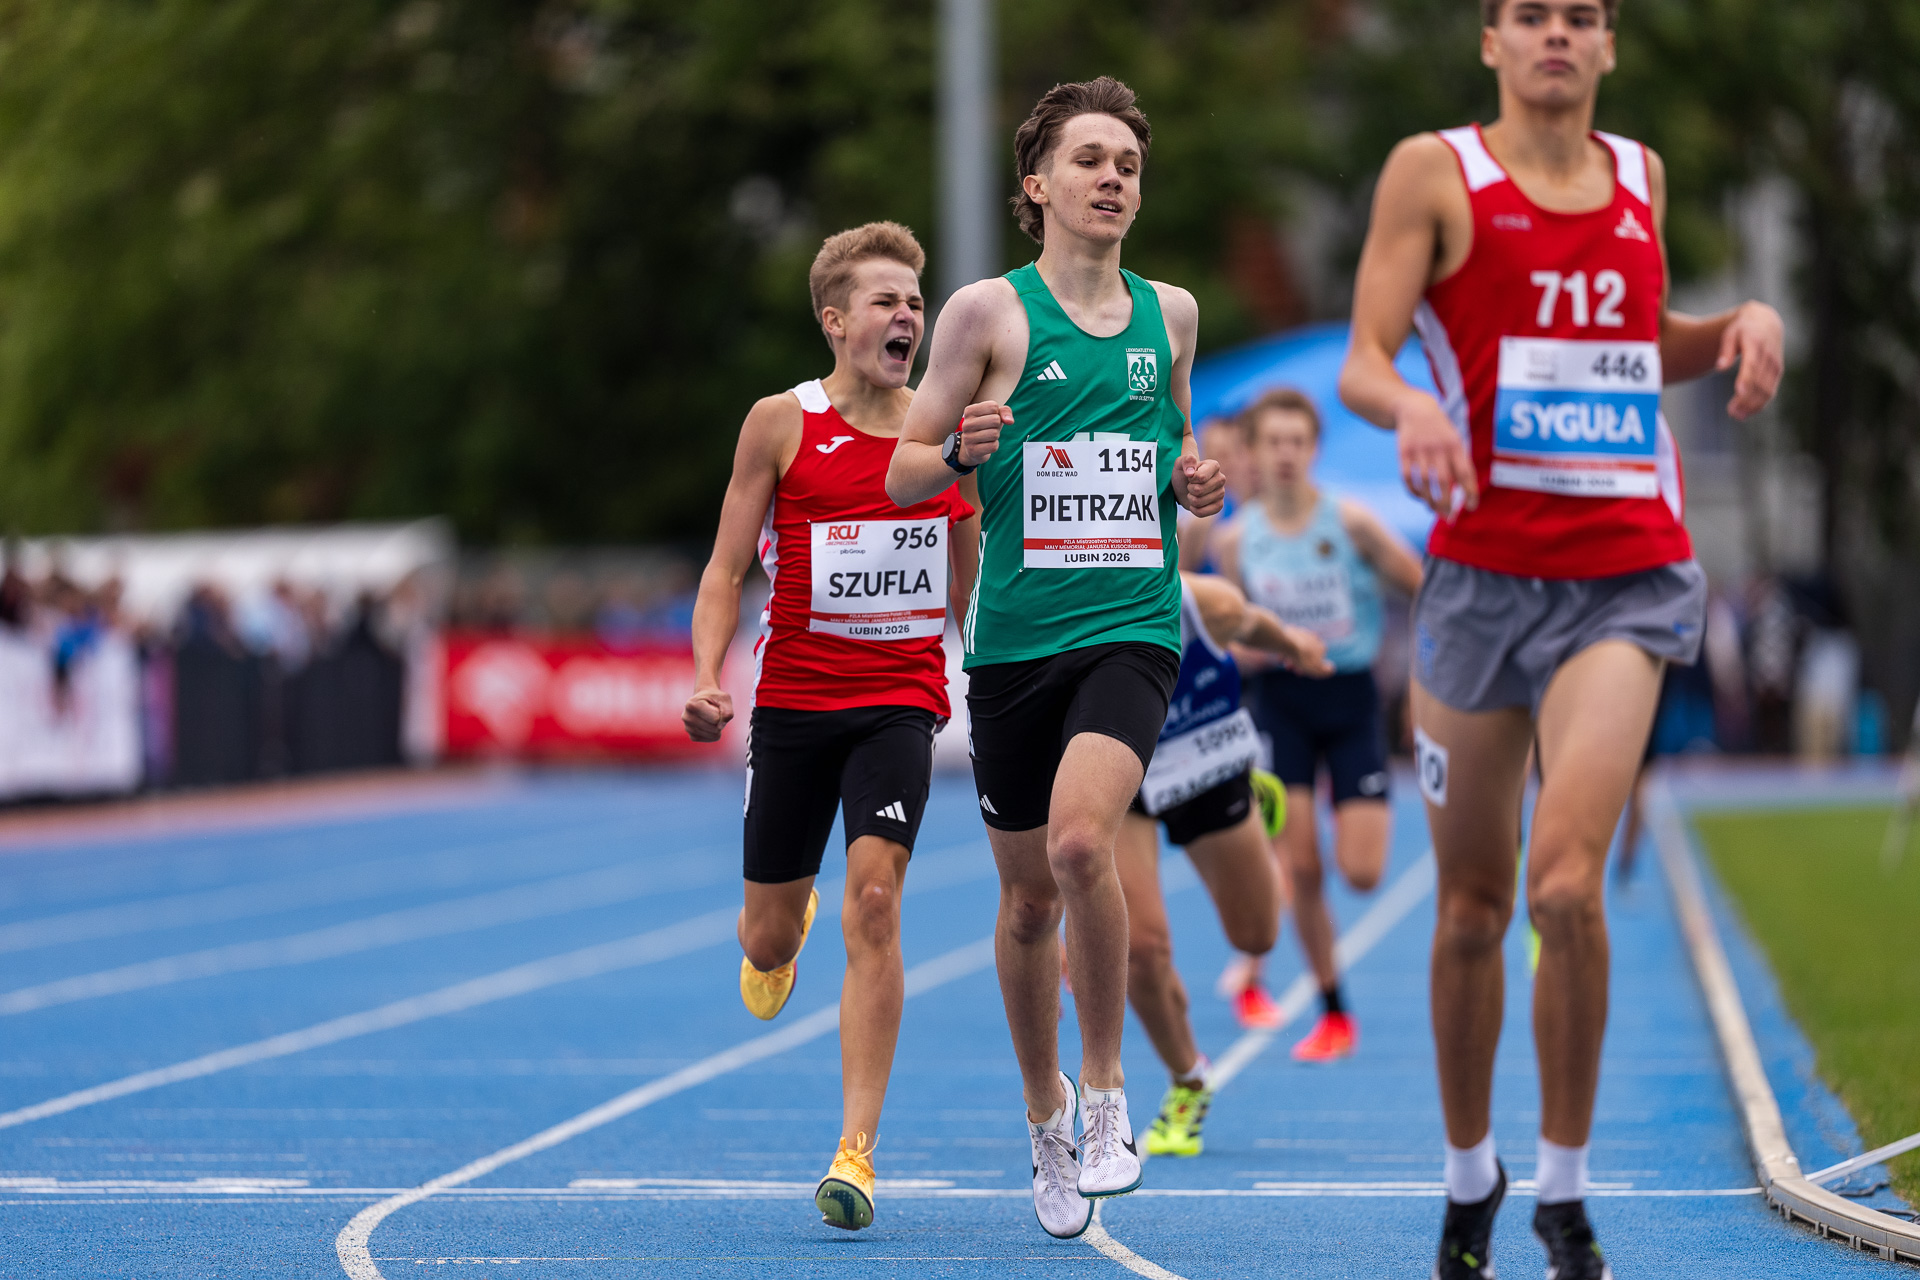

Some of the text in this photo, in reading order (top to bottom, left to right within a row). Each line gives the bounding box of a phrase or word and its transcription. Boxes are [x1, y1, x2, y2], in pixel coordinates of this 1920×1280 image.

[1529, 269, 1626, 328] 712
[1591, 350, 1648, 382] 446
[1510, 401, 1646, 445] SYGUŁA
[1098, 448, 1153, 473] 1154
[1030, 494, 1156, 522] PIETRZAK
[892, 525, 938, 551] 956
[1064, 552, 1131, 563] LUBIN 2026
[828, 569, 933, 599] SZUFLA
[848, 624, 910, 635] LUBIN 2026
